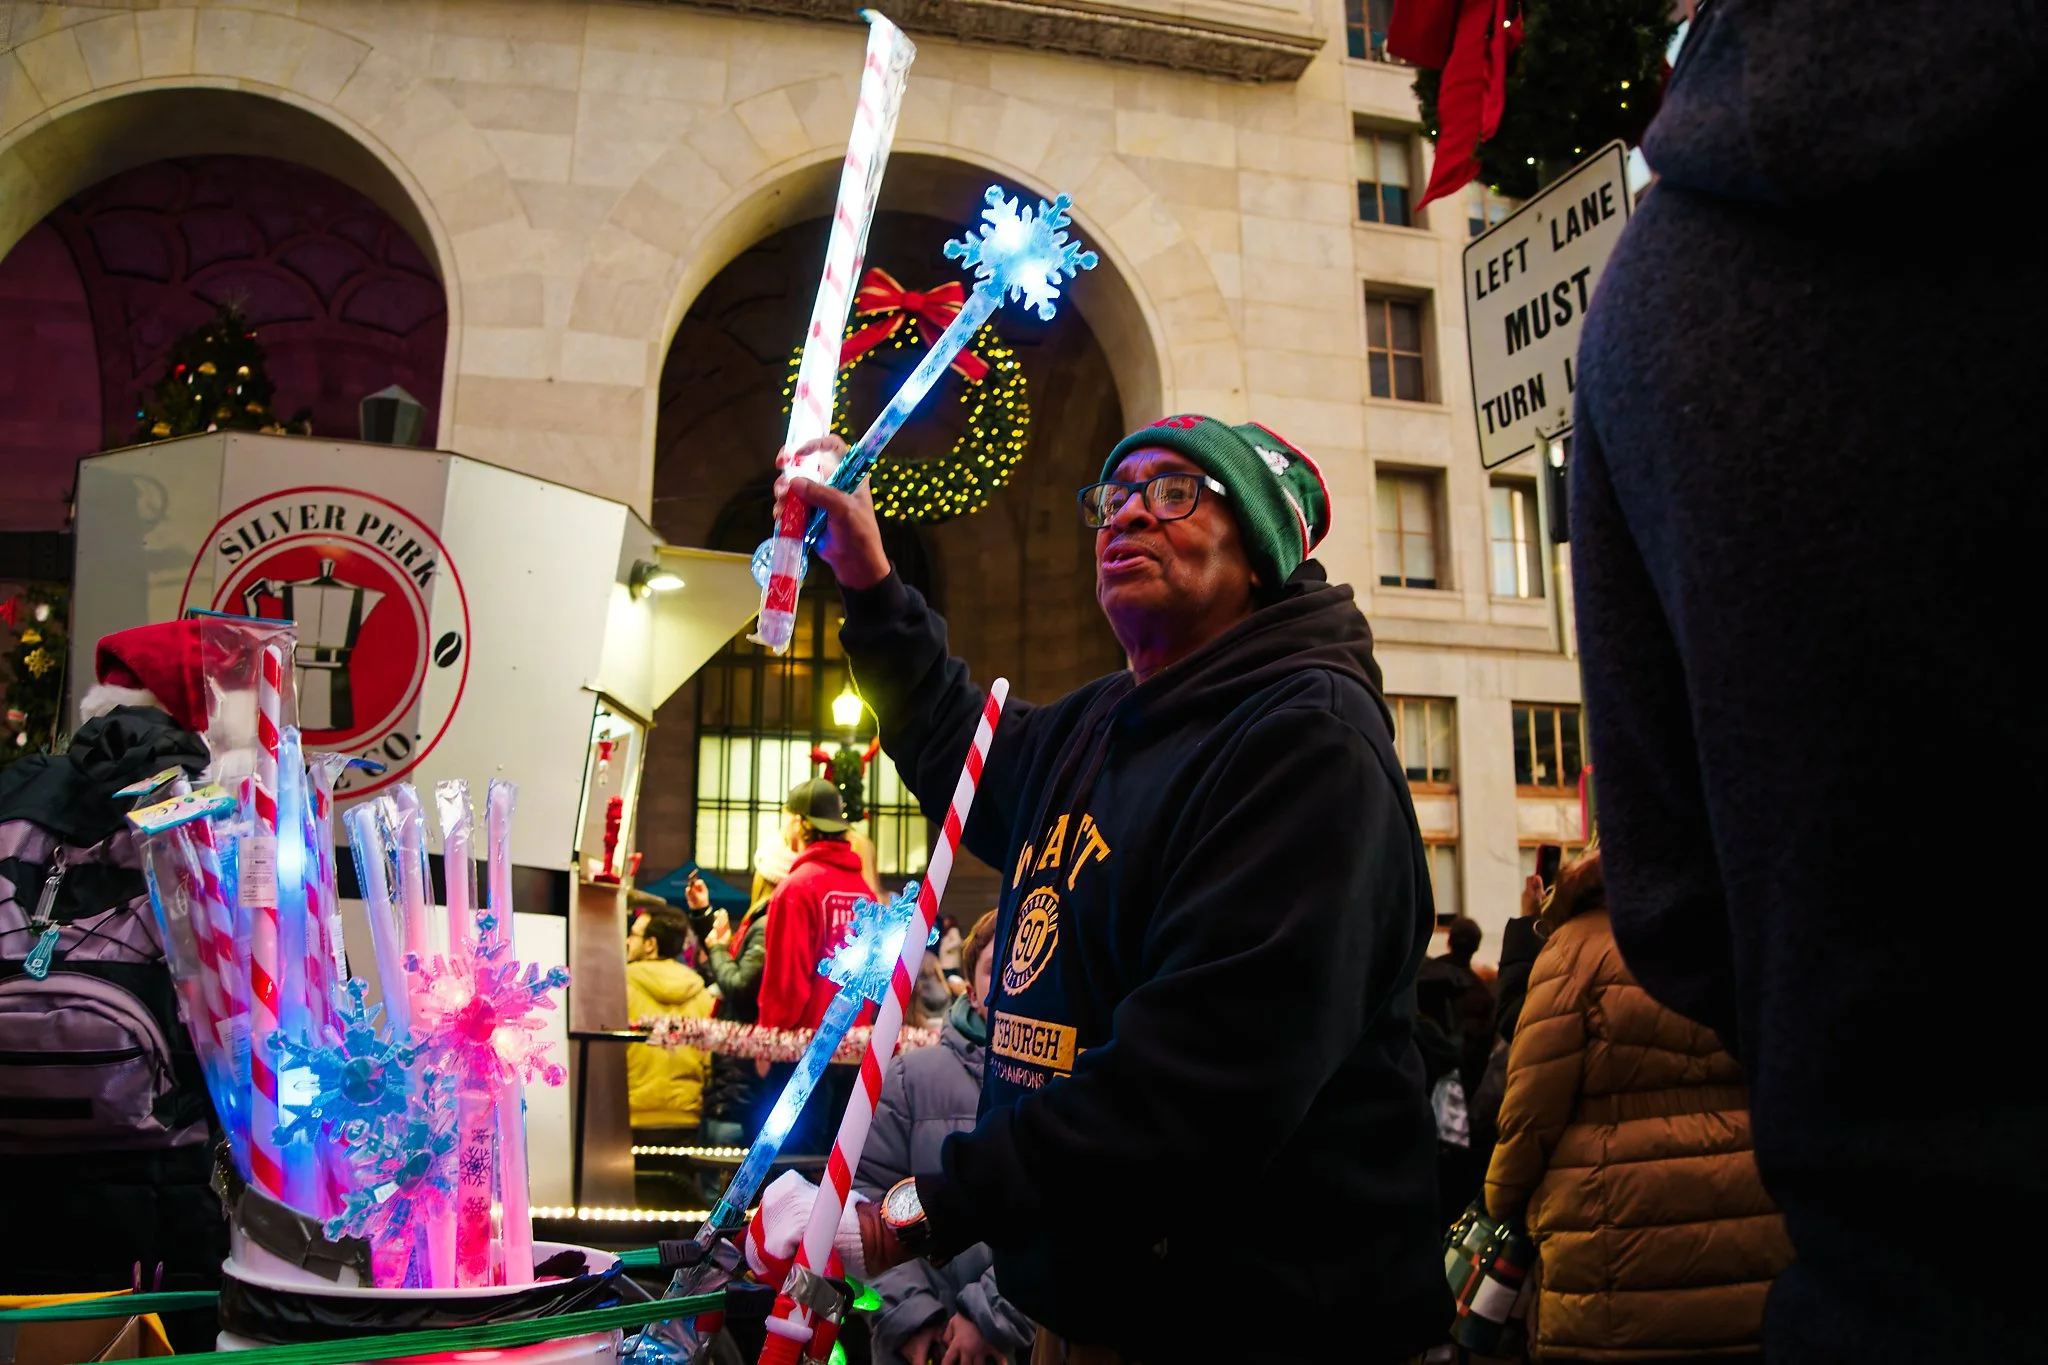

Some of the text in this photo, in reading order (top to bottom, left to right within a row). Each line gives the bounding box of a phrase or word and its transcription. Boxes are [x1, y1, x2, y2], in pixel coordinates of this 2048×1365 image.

[1475, 182, 1616, 300] LEFT LANE
[1504, 266, 1591, 356] MUST
[1482, 373, 1547, 434] TURN
[219, 504, 435, 589] SILVER PERK
[1016, 919, 1045, 962] 90
